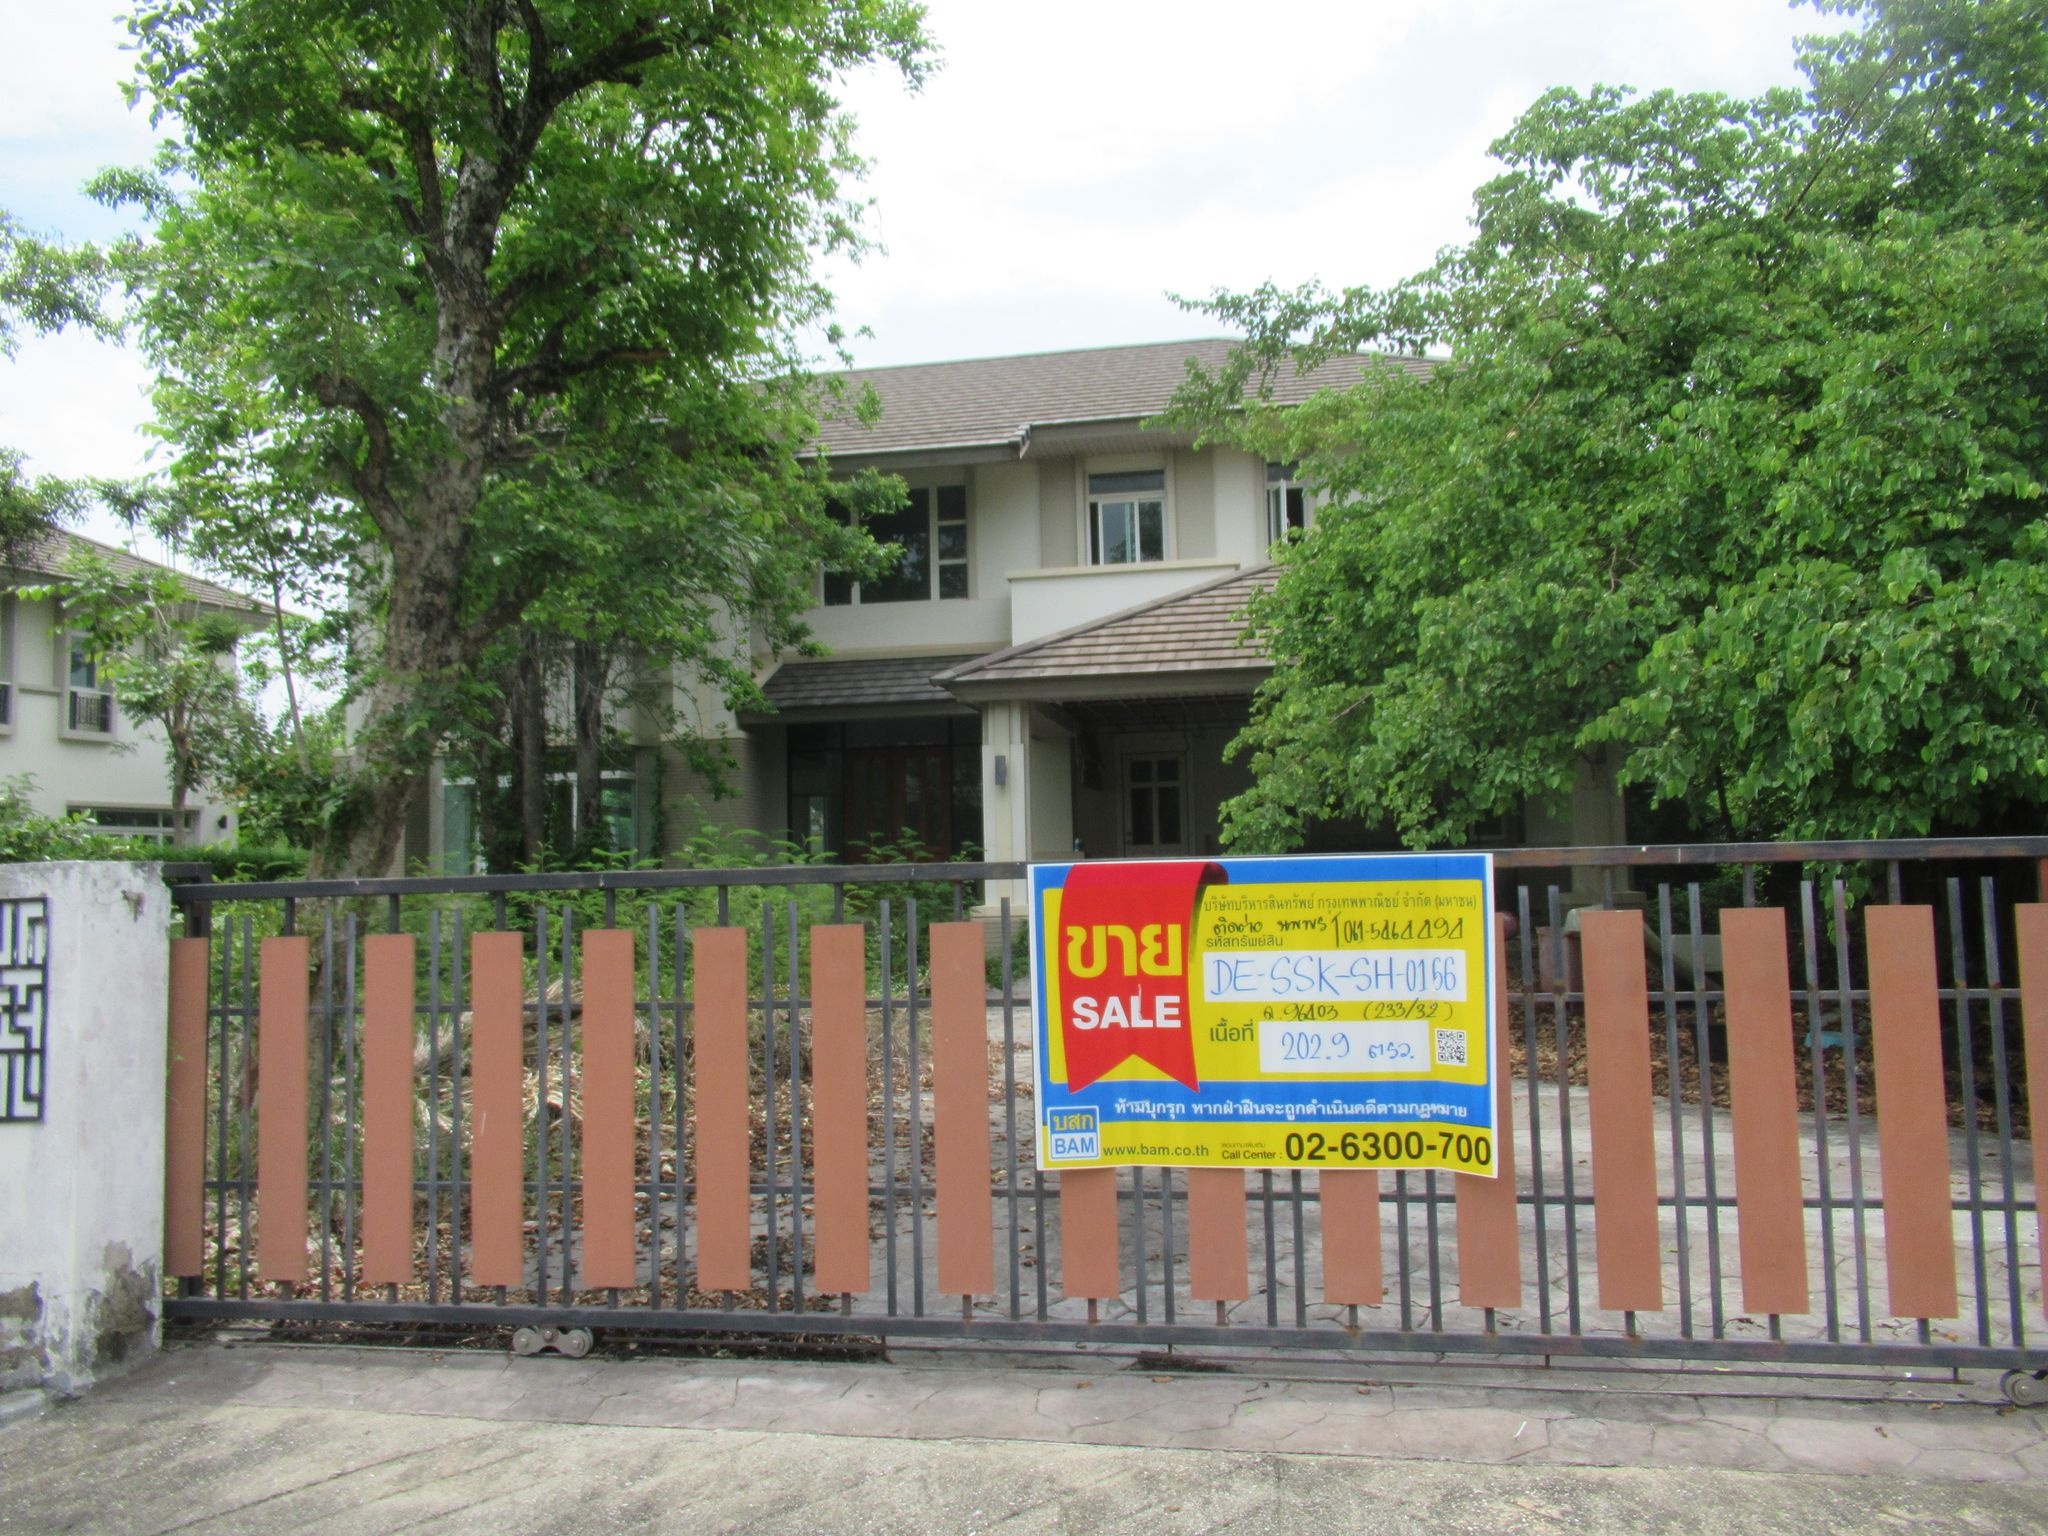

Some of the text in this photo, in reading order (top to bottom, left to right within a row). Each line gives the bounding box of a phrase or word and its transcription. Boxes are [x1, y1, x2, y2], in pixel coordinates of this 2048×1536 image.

[1205, 891, 1477, 914] บริษัทบริหารสินทรัพย์ กรุงเทพพาณิชย์ จำกัด (มหาชน)
[1066, 923, 1183, 979] ขาย
[1206, 934, 1283, 948] รหัสทรัพย์สิน
[1072, 995, 1182, 1030] SALE
[1210, 1017, 1254, 1043] เนื้อที่
[1281, 1031, 1350, 1061] 202.9
[1115, 1098, 1186, 1120] ห้ามบุกรุก
[1053, 1113, 1094, 1132] บสก
[1054, 1136, 1095, 1156] BAM
[1103, 1142, 1209, 1157] www.bam.co.th
[1222, 1149, 1241, 1159] Call
[1243, 1149, 1276, 1159] Center
[1285, 1131, 1492, 1166] 02-6300-700
